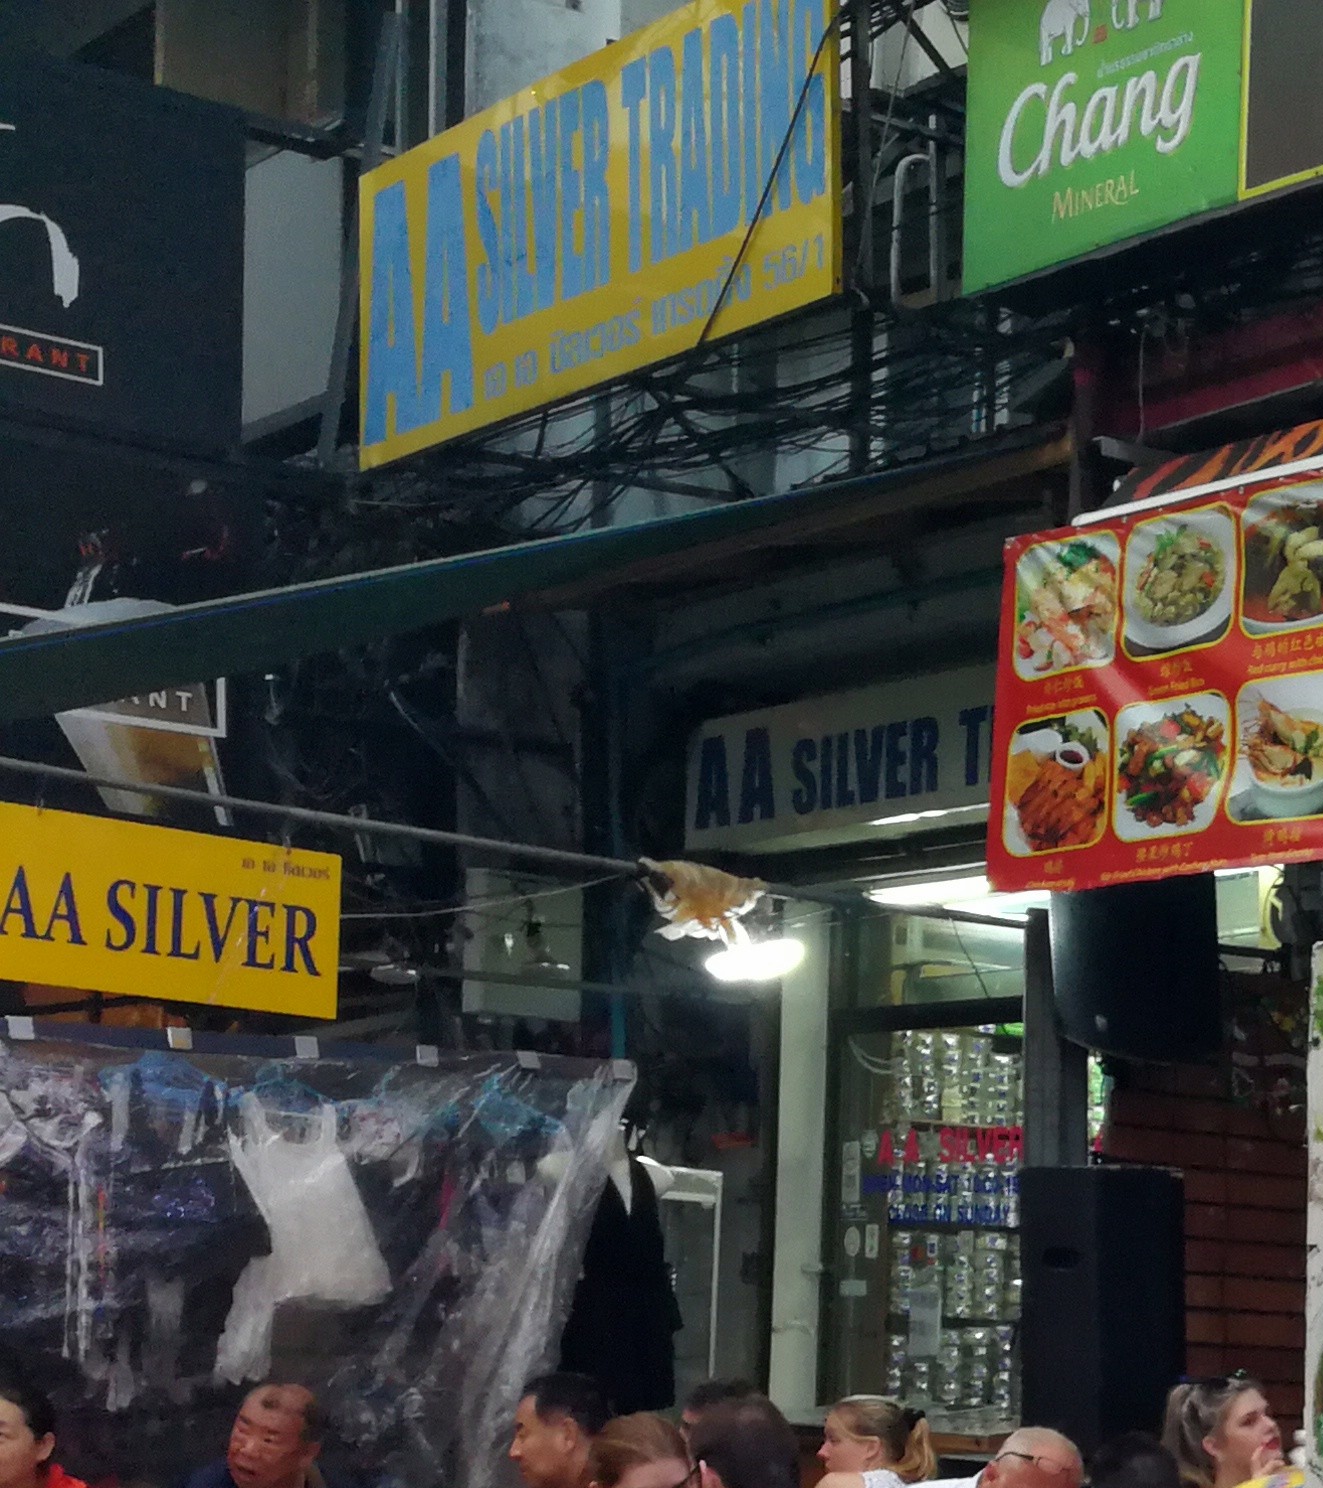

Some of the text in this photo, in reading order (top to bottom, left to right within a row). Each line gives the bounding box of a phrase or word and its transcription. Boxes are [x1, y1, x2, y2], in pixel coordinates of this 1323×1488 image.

[997, 52, 1203, 189] Chang
[364, 0, 827, 446] AA SILVER TRADING
[761, 232, 826, 291] 56/1
[695, 727, 775, 830] AA
[790, 716, 940, 816] SILVER
[0, 865, 321, 977] AA SILVER
